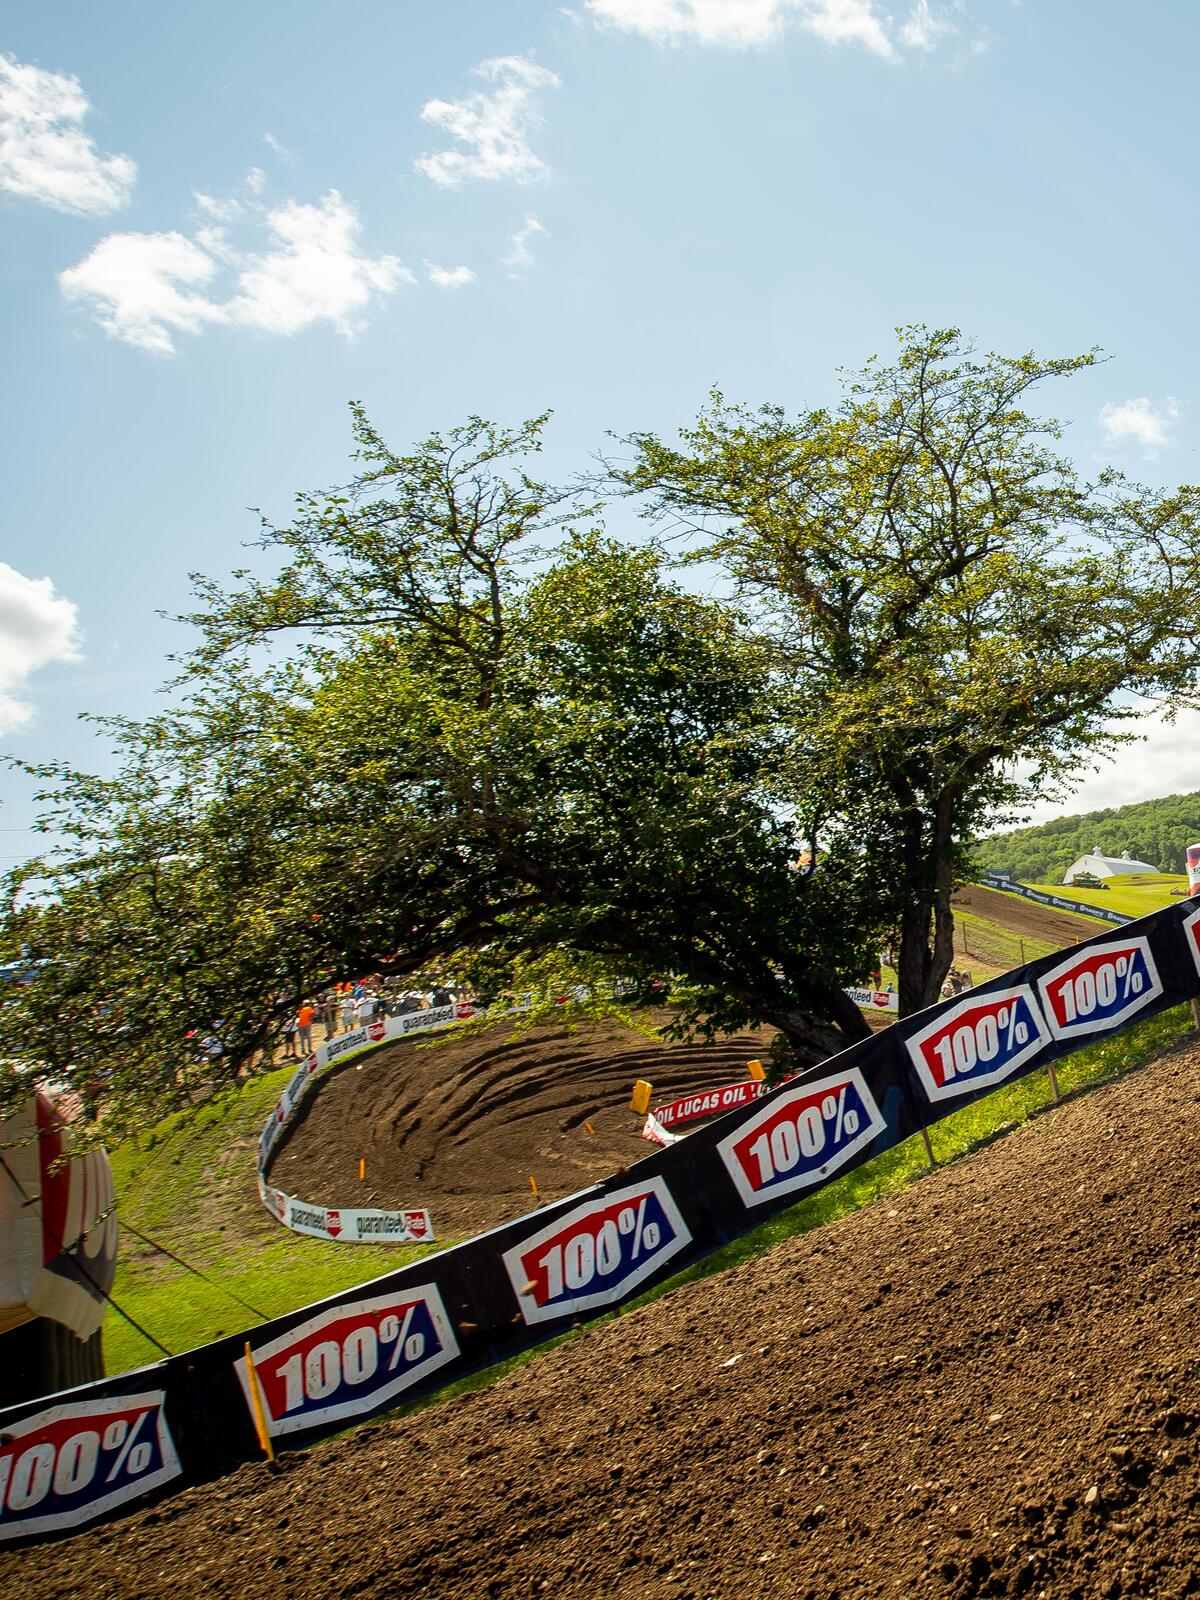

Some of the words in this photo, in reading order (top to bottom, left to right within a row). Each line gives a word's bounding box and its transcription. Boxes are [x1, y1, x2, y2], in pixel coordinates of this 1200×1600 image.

[402, 1005, 453, 1033] guaranteed
[1056, 949, 1143, 1023] 100%
[933, 1005, 1028, 1082] 100%
[677, 1093, 720, 1118] LUCAS
[723, 1087, 746, 1105] OIL
[748, 1087, 858, 1186] 100%
[357, 1213, 406, 1238] guaranteed
[537, 1199, 661, 1306] 100%
[275, 1306, 425, 1408] 100%
